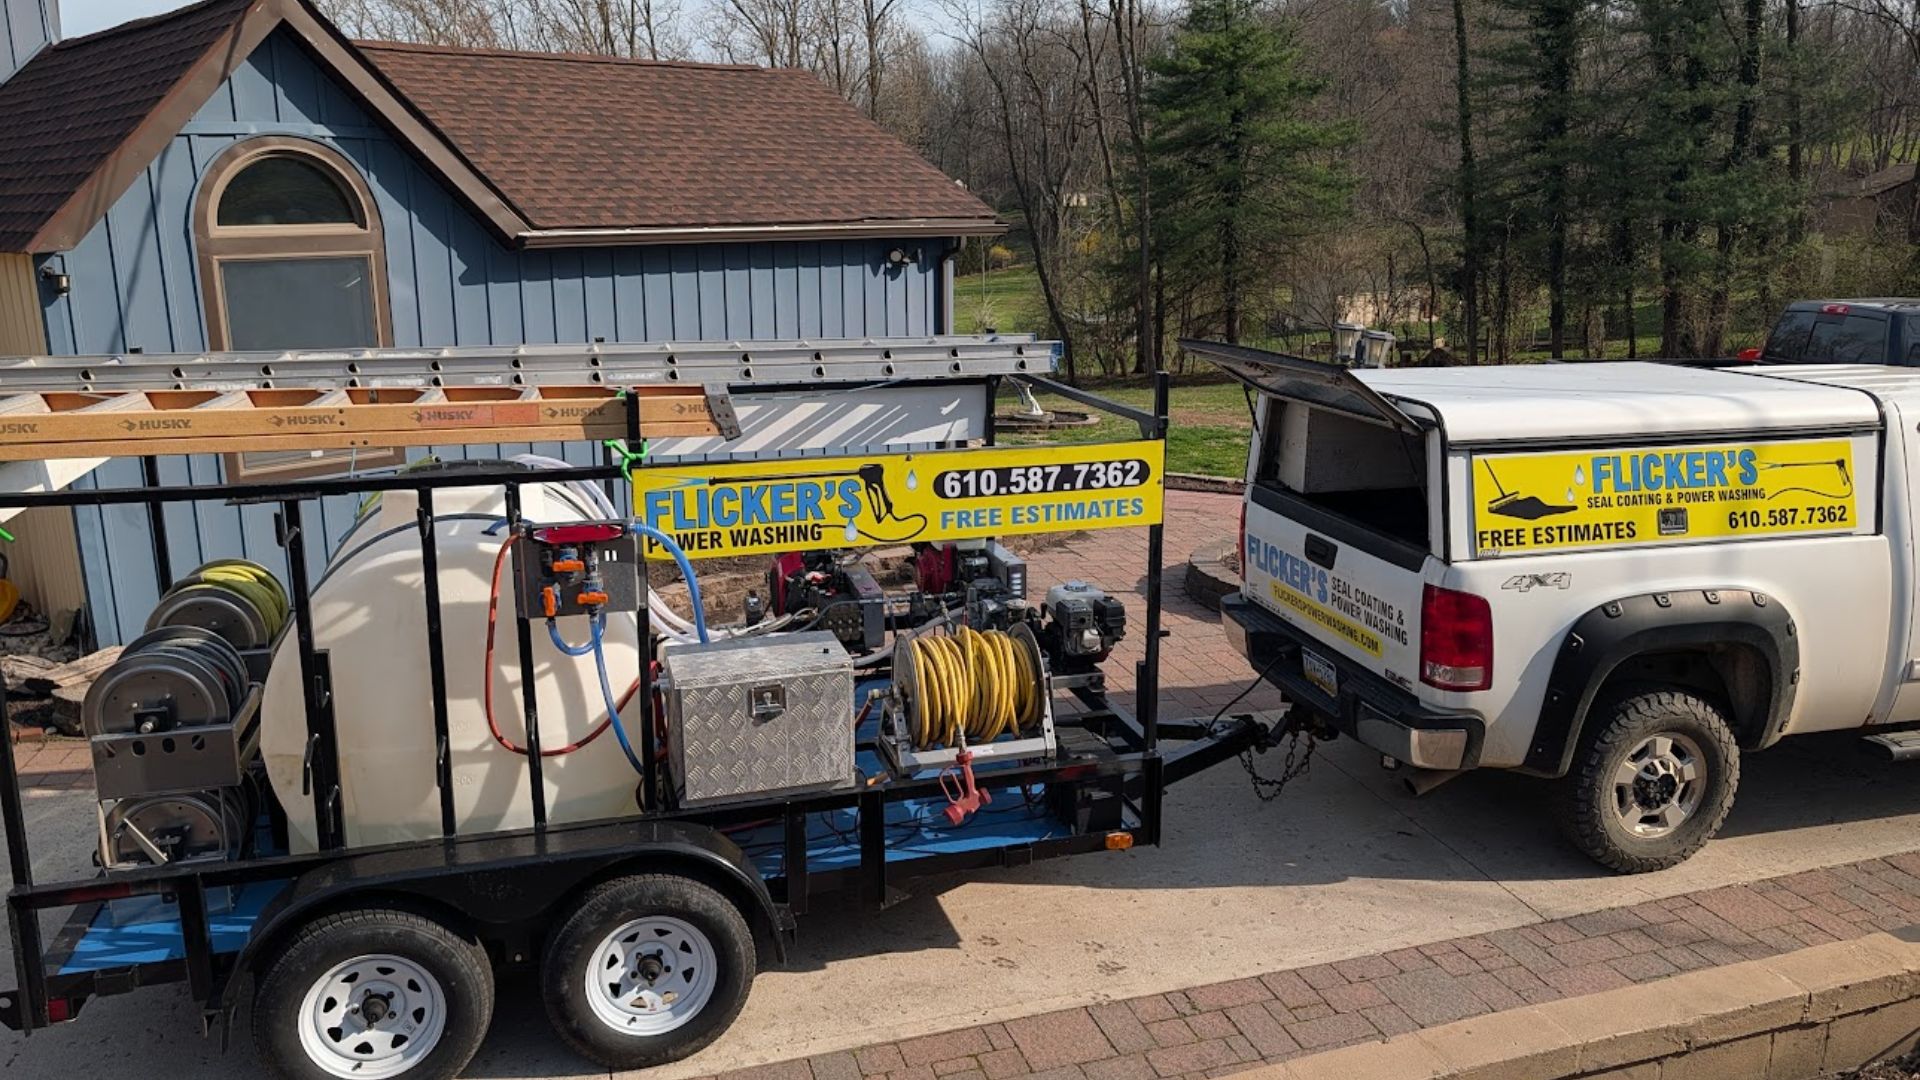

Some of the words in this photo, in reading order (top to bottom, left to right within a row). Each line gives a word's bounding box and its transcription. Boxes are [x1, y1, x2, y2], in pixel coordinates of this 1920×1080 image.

[139, 418, 191, 431] HUSKY
[287, 414, 336, 426] HUSKY
[427, 409, 474, 421] HUSKY
[560, 406, 606, 418] HUSKY
[0, 423, 38, 434] USKY
[943, 460, 1141, 498] 610.587.7362
[1592, 449, 1759, 493] FLICKER'S
[644, 479, 862, 532] FLICKER'S
[1587, 494, 1613, 509] SEAL
[1617, 493, 1661, 507] COATING
[1666, 493, 1674, 504] &
[1677, 490, 1715, 504] POWER
[1718, 488, 1766, 501] WASHING
[940, 508, 1002, 530] FREE
[1011, 498, 1143, 524] ESTIMATES
[1728, 504, 1848, 529] 610.587.7362
[729, 523, 822, 548] WASHING
[1478, 528, 1526, 549] FREE
[1533, 521, 1636, 545] ESTIMATES
[1247, 533, 1328, 604] FLICKER'S
[1332, 576, 1352, 599] SEAL
[1355, 587, 1394, 621] COATING
[1396, 610, 1404, 626] &
[1332, 594, 1361, 622] POWER
[1364, 610, 1408, 646] WASHING
